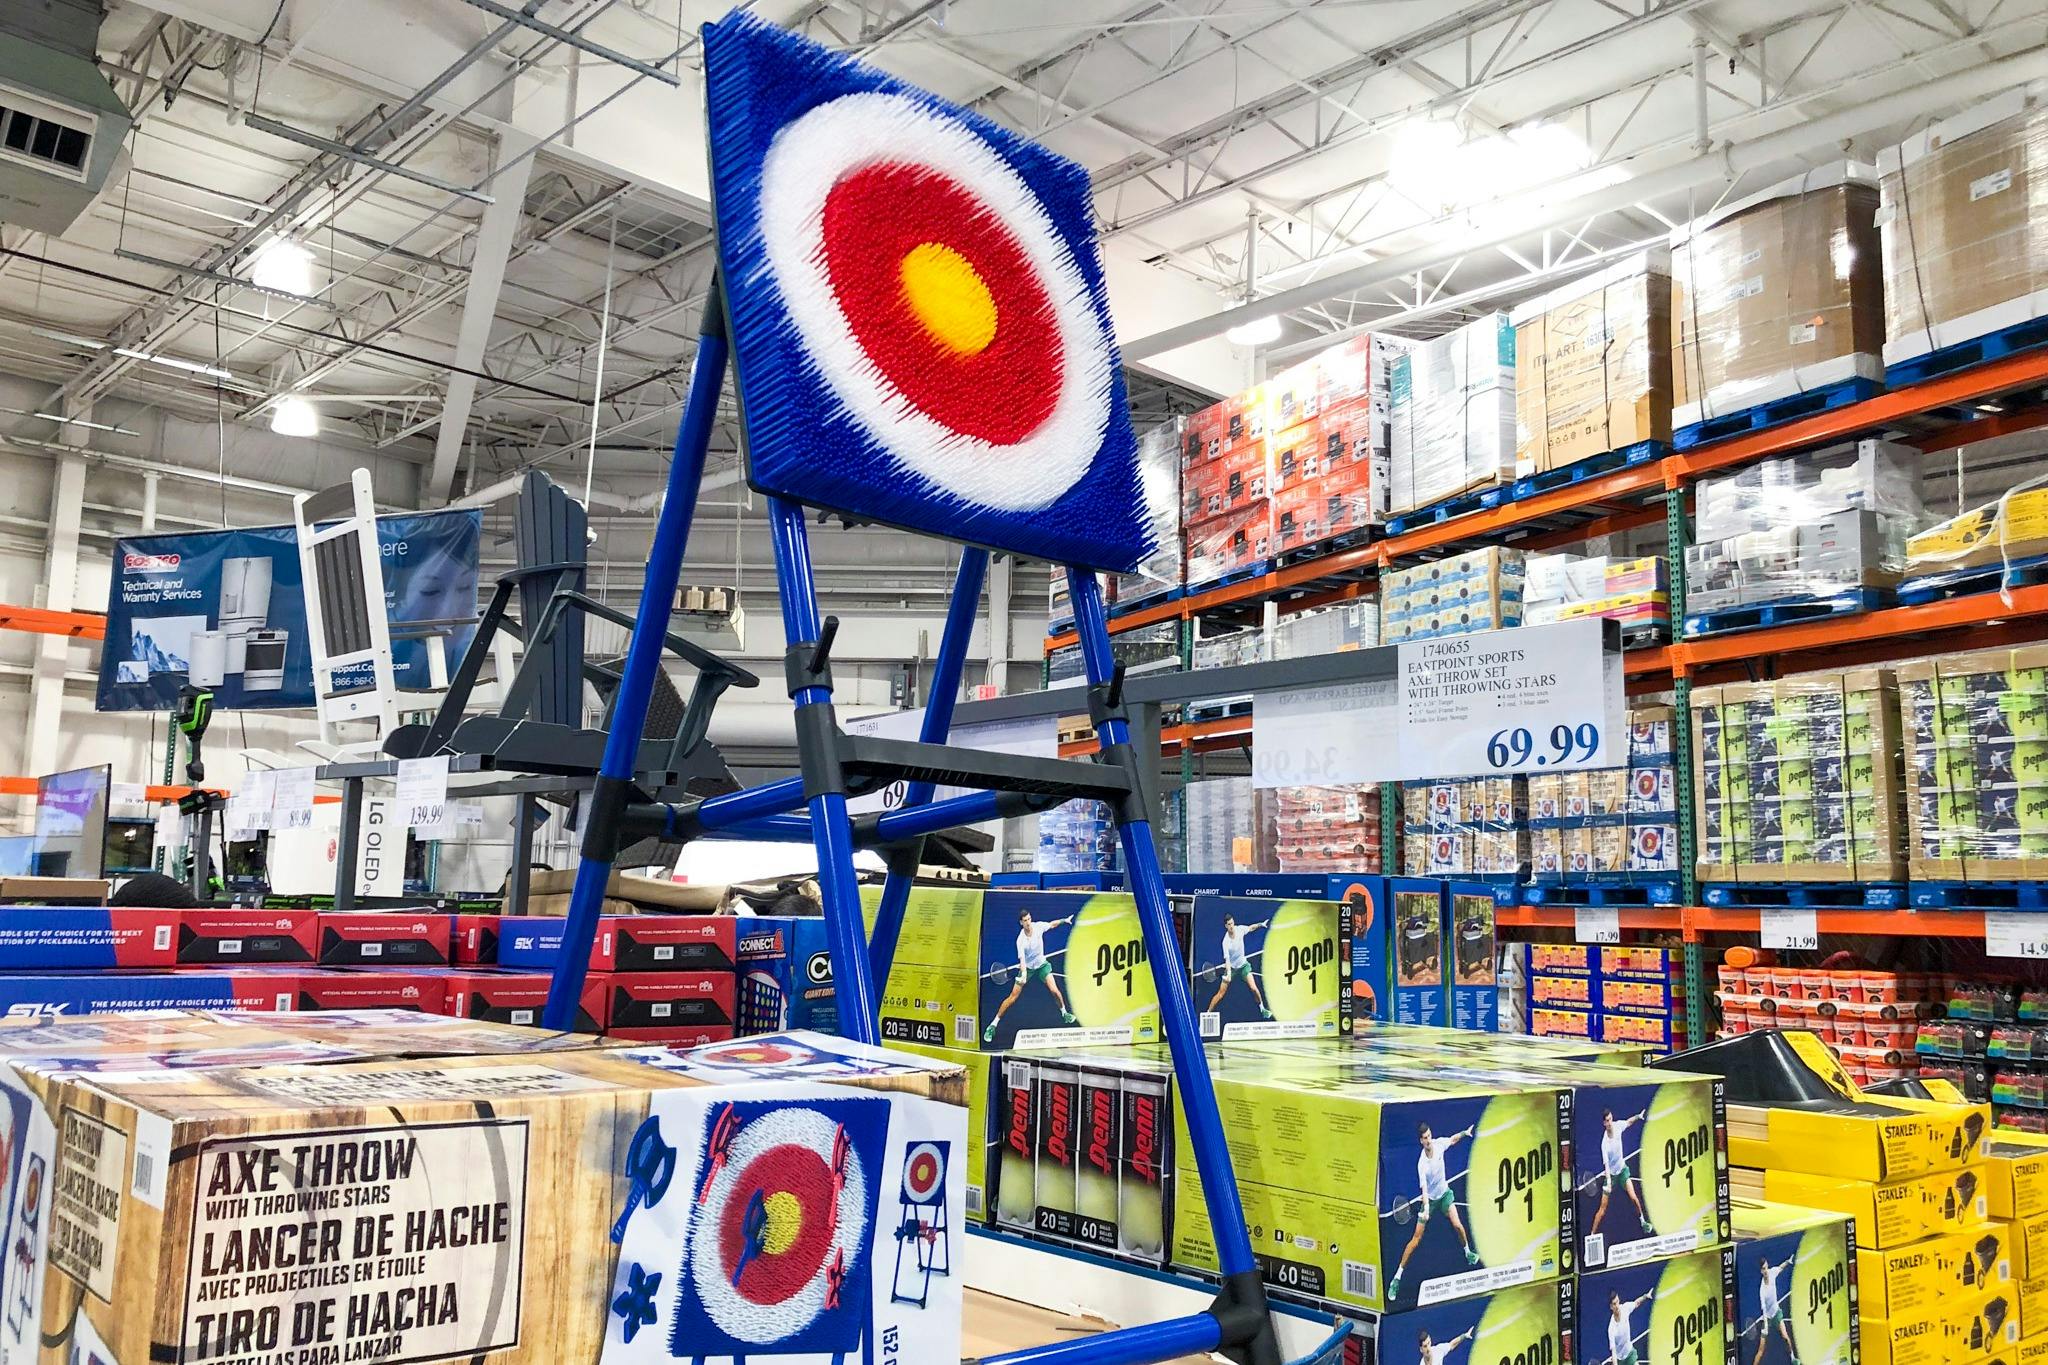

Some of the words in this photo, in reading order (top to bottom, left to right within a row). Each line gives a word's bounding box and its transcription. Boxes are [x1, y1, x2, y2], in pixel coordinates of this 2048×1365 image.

[122, 580, 163, 591] Technical
[164, 578, 183, 589] and
[122, 592, 161, 603] Warranty
[162, 589, 202, 601] Services
[1421, 640, 1470, 658] 1740655
[1408, 656, 1474, 674] EASTPOINT
[1478, 649, 1525, 666] SPORTS
[1408, 672, 1432, 687] AXE
[1437, 668, 1482, 684] THROW
[1484, 665, 1508, 679] SET
[1408, 687, 1439, 700] WITH
[1442, 678, 1511, 697] THROWING
[1514, 673, 1557, 689] STARS
[1487, 723, 1599, 768] 69.99
[369, 801, 384, 825] LG
[410, 805, 443, 825] 139.99
[364, 832, 382, 881] OLED
[1341, 907, 1351, 917] 20
[412, 923, 427, 933] PPA
[702, 925, 716, 936] PPA
[1595, 931, 1619, 942] 17.99
[739, 937, 775, 952] CONNECT
[774, 928, 785, 952] 4
[1786, 936, 1816, 948] 21.99
[2020, 942, 2048, 955] 14.9
[699, 981, 713, 992] PPA
[1123, 970, 1133, 997] 1
[1308, 970, 1317, 995] 1
[402, 986, 419, 998] PPA
[1341, 988, 1351, 998] 60
[886, 1021, 898, 1036] 20
[916, 1025, 929, 1040] 60
[1714, 1083, 1724, 1096] 20
[1559, 1095, 1570, 1109] 20
[1885, 1122, 1918, 1140] STANLEY
[207, 1148, 280, 1197] AXE
[292, 1137, 417, 1189] THROW
[2015, 1162, 2041, 1177] STANLEY
[1685, 1165, 1694, 1197] 1
[1718, 1184, 1728, 1197] 60
[1878, 1186, 1909, 1204] STANLEY
[205, 1198, 248, 1221] WITH
[254, 1189, 340, 1216] THROWING
[343, 1184, 391, 1207] STARS
[1523, 1188, 1534, 1223] 1
[1041, 1211, 1056, 1229] 20
[1561, 1207, 1572, 1222] 60
[1081, 1221, 1097, 1240] 60
[1847, 1221, 1854, 1234] 20
[201, 1218, 342, 1278] LANCER
[353, 1214, 394, 1259] DE
[404, 1202, 508, 1253] HACHE
[1723, 1252, 1733, 1266] 20
[1889, 1253, 1924, 1272] STANLEY
[196, 1279, 240, 1302] AVEC
[245, 1265, 350, 1296] PROJECTILES
[354, 1263, 372, 1282] EN
[377, 1255, 426, 1279] ÉTOILE
[1278, 1264, 1298, 1285] 60
[1561, 1282, 1572, 1297] 20
[195, 1305, 280, 1360] TIRO
[291, 1298, 336, 1347] DE
[348, 1282, 459, 1339] HACHA
[1826, 1300, 1833, 1329] 1
[883, 1325, 898, 1355] 152
[1894, 1320, 1929, 1342] STANLEY
[299, 1346, 340, 1365] PARA
[344, 1336, 402, 1363] LANZAR
